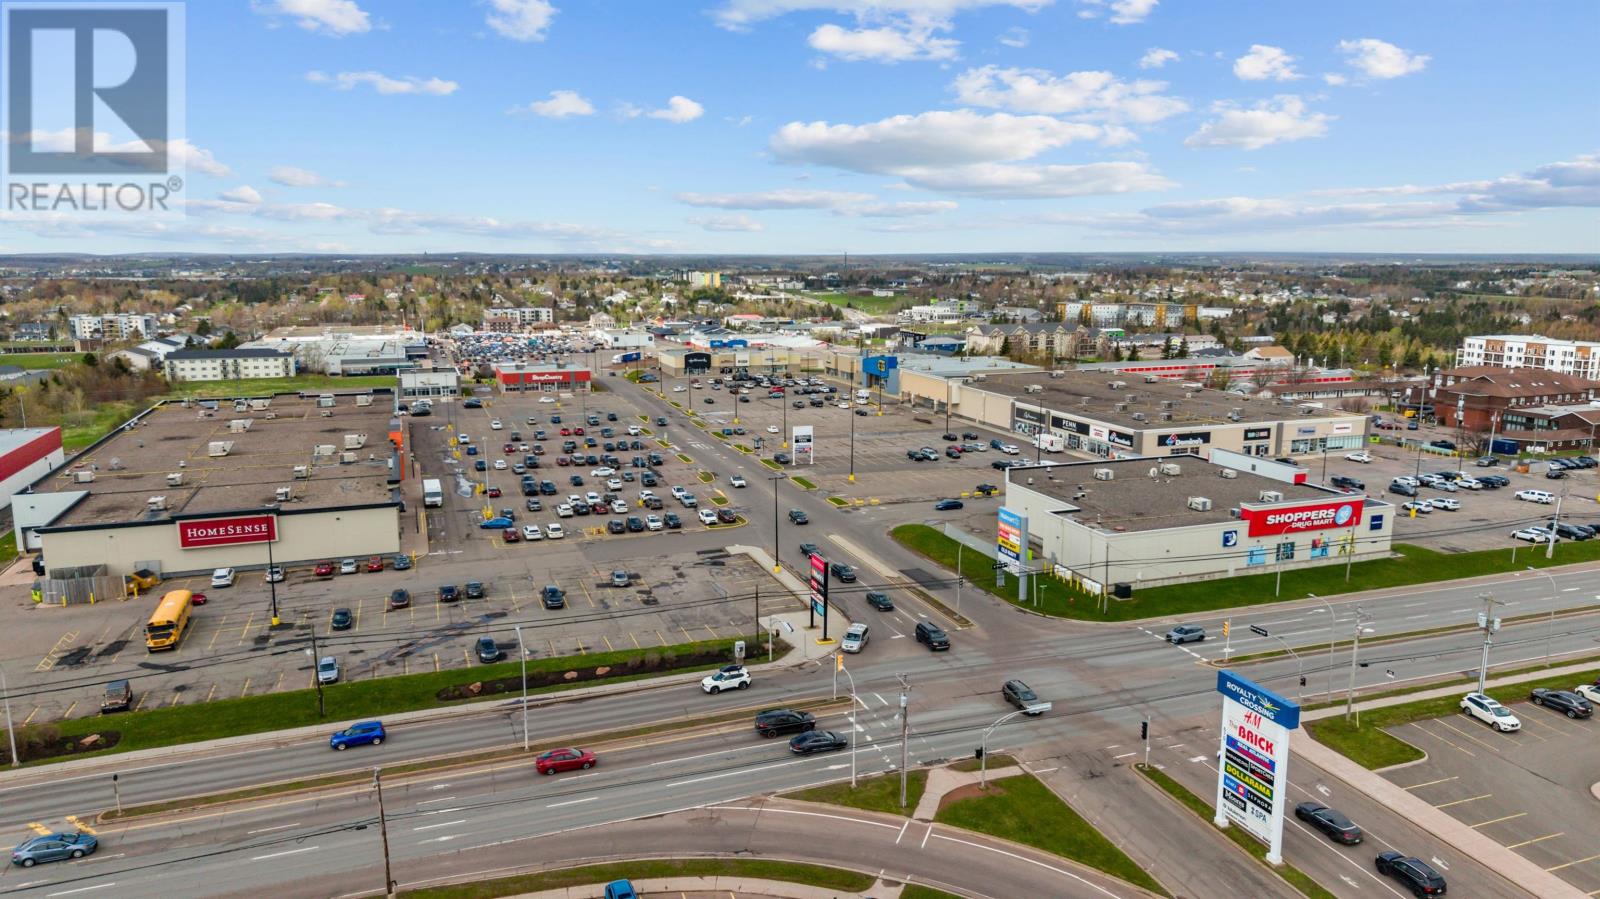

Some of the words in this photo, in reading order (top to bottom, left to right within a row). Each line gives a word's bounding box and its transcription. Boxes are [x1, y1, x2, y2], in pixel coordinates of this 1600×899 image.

[1266, 508, 1336, 524] SHOPPERS
[1292, 520, 1312, 529] DRUG
[1313, 518, 1334, 526] MART
[1226, 681, 1257, 701] ROYALTY
[1240, 697, 1275, 720] CROSSING
[1238, 725, 1274, 755] BRICK
[1226, 764, 1271, 797] DOLLARAMA
[1247, 792, 1272, 811] SEPHORA
